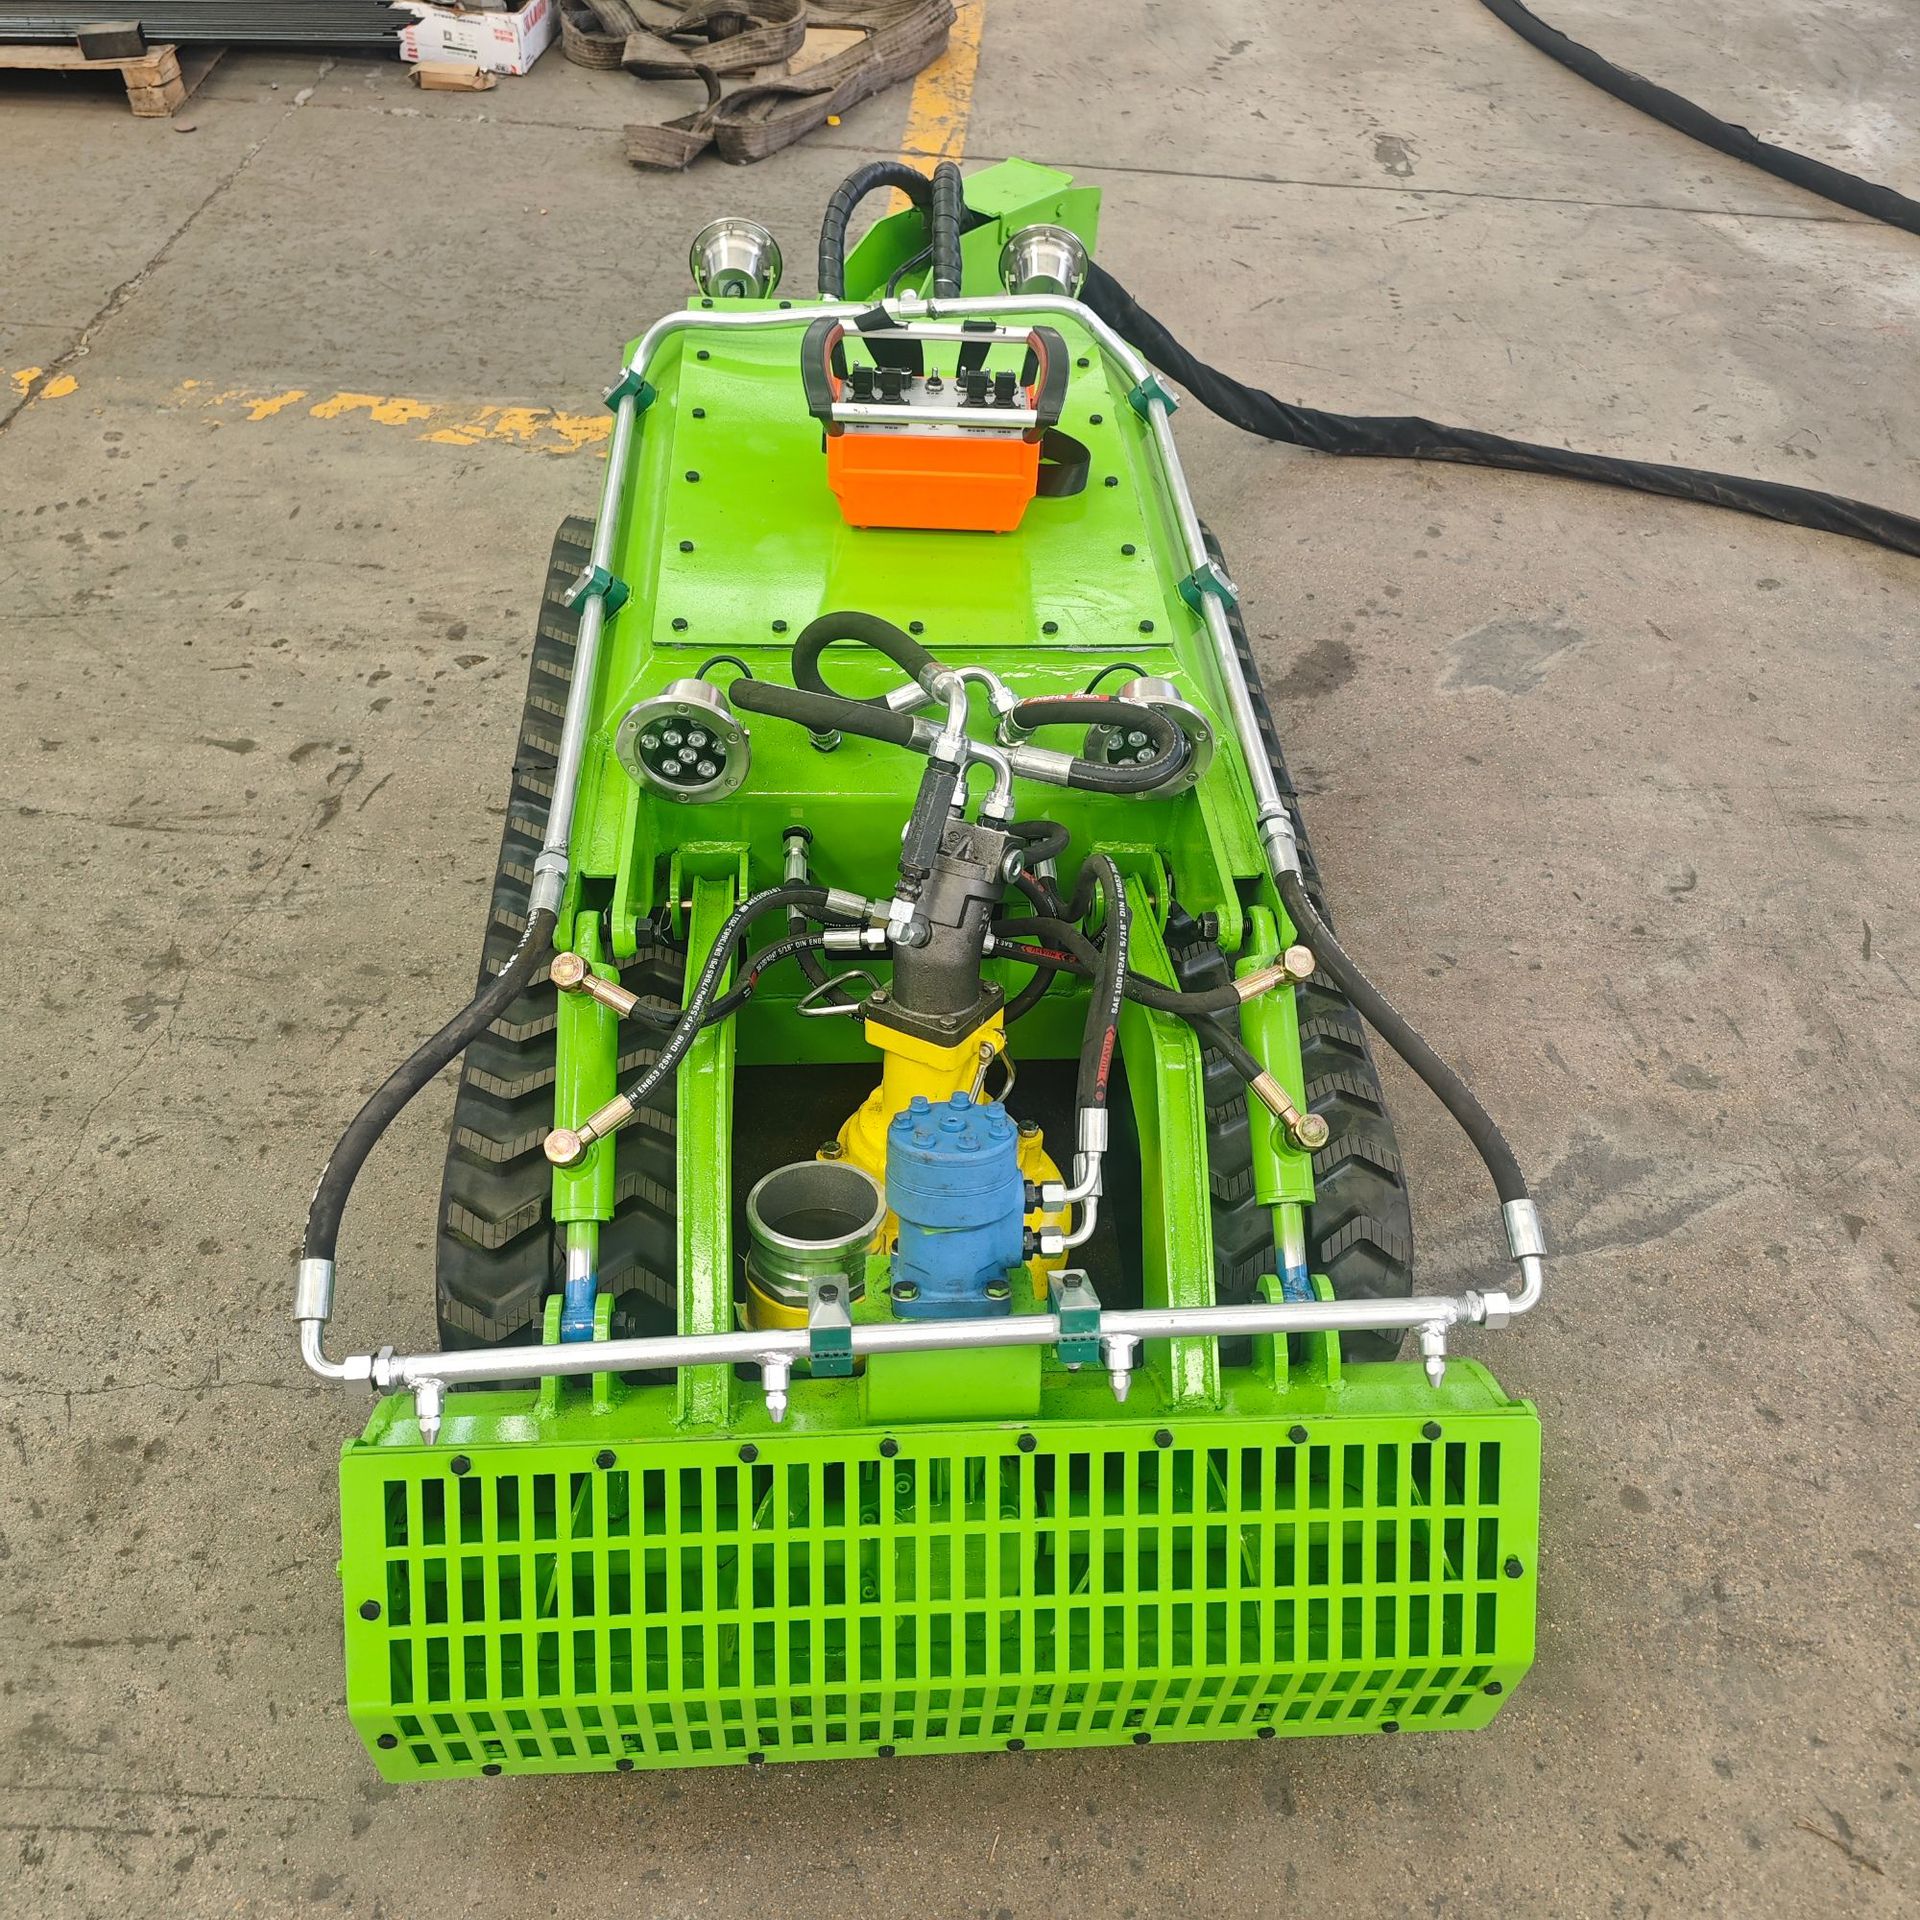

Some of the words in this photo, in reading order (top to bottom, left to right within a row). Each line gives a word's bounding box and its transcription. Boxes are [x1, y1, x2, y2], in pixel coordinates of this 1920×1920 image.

[1118, 901, 1126, 917] DIN
[1117, 952, 1126, 975] R2AT
[1111, 996, 1121, 1015] SAE
